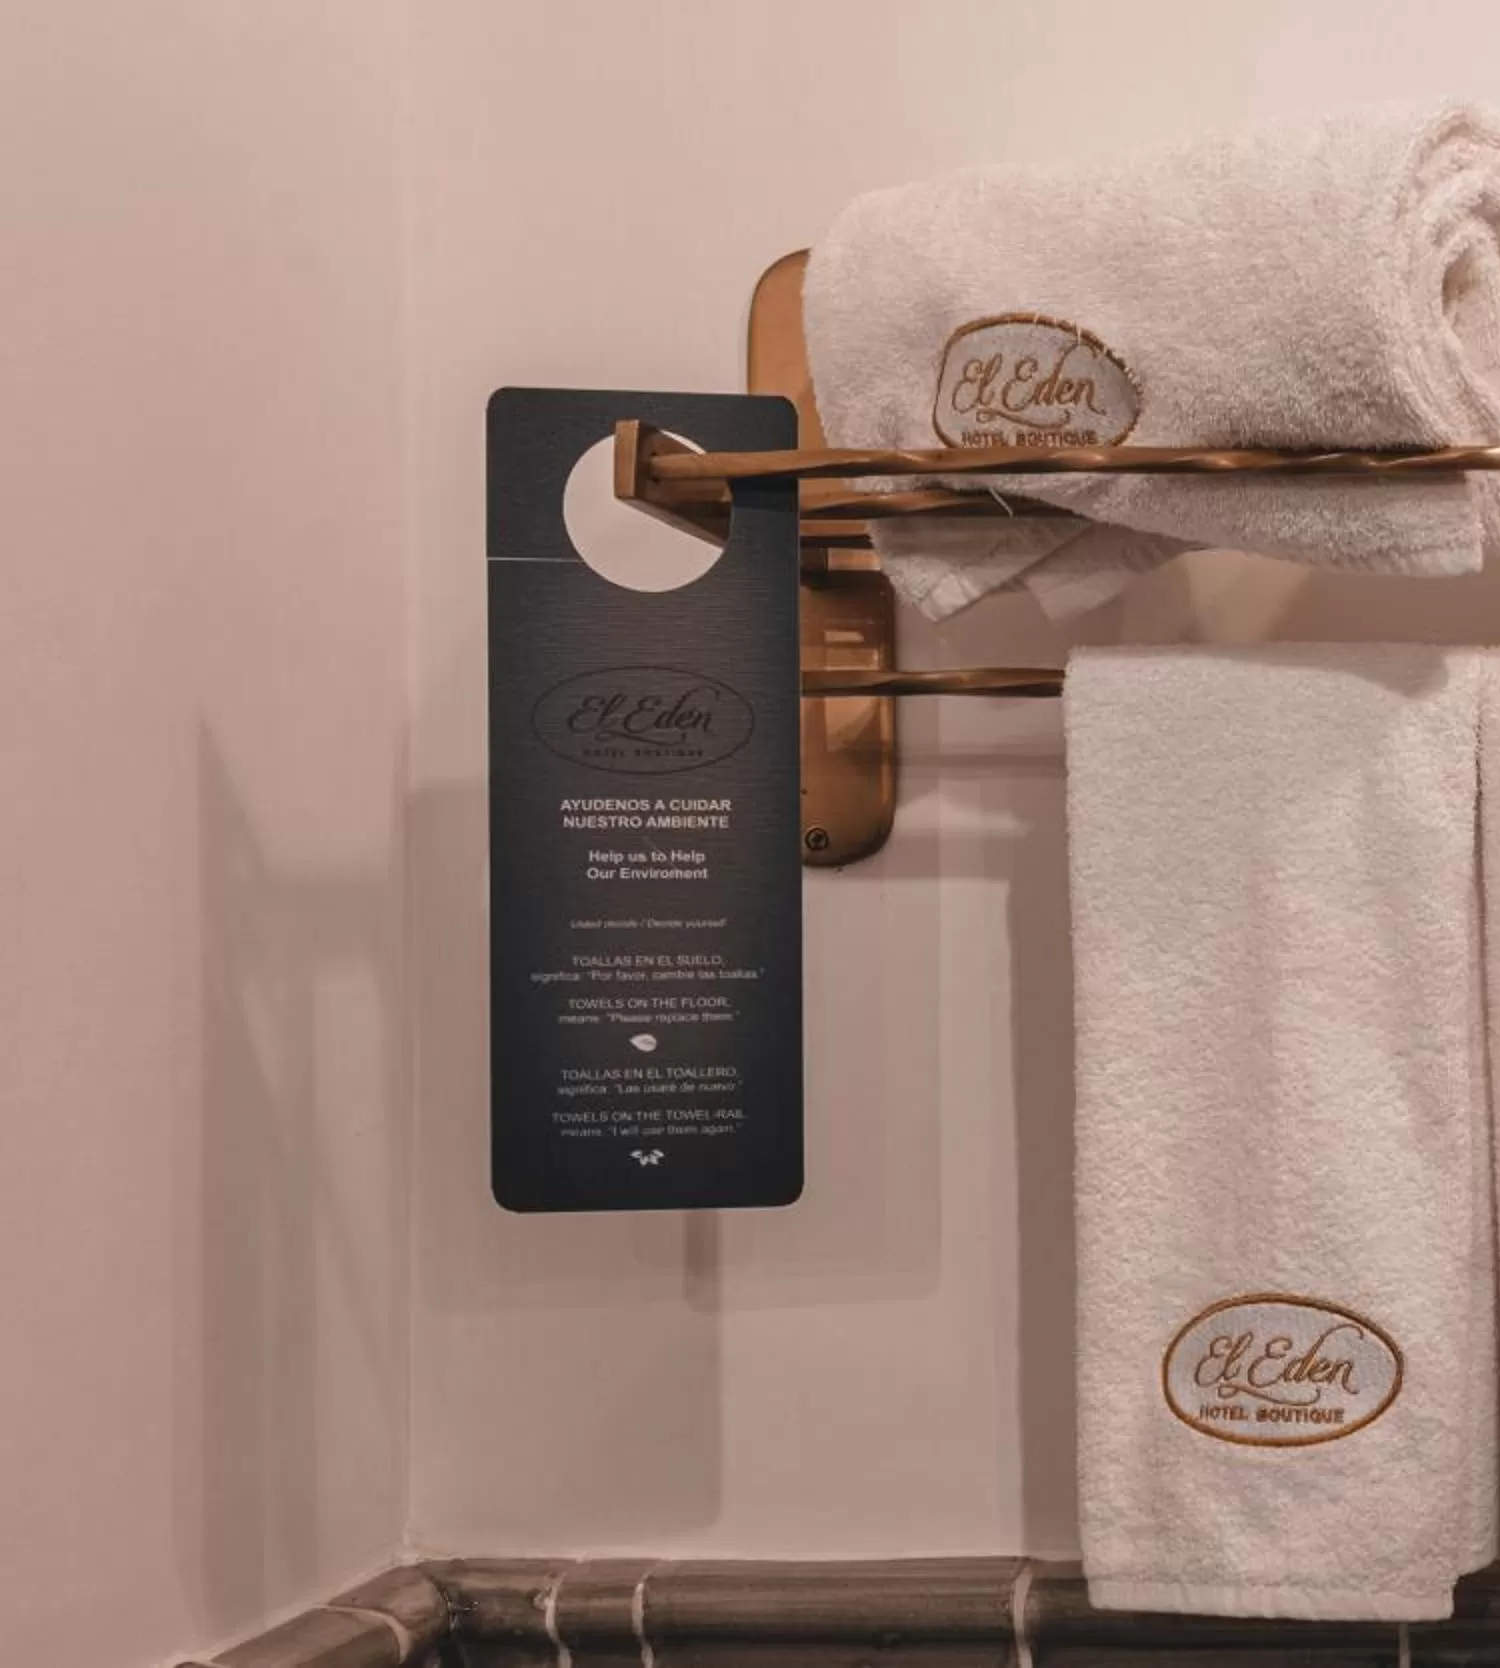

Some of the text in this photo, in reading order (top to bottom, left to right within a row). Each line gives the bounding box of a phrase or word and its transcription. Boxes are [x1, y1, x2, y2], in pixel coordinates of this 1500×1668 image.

[951, 343, 1107, 420] El Eden
[961, 429, 1099, 447] HOTEL BOUTIQUE
[560, 799, 733, 812] AYUDENOS A CUIDAR
[562, 815, 730, 829] NUESTRO AMBIENTE
[588, 849, 706, 865] Help us to Help
[586, 867, 709, 880] Our Enviroment
[572, 955, 632, 967] TOALLAS
[635, 955, 654, 967] EN
[657, 955, 674, 966] EL
[568, 998, 625, 1010] TOWELS
[627, 998, 648, 1009] ON
[651, 997, 677, 1009] THE
[561, 1069, 623, 1081] TOALLAS
[623, 1068, 643, 1080] EN
[646, 1068, 663, 1079] EL
[552, 1112, 609, 1123] TOWELS
[611, 1111, 633, 1122] ON
[636, 1110, 662, 1121] THE
[1193, 1323, 1365, 1396] El Eden
[1199, 1404, 1345, 1424] HOTEL BOUTIQUE
